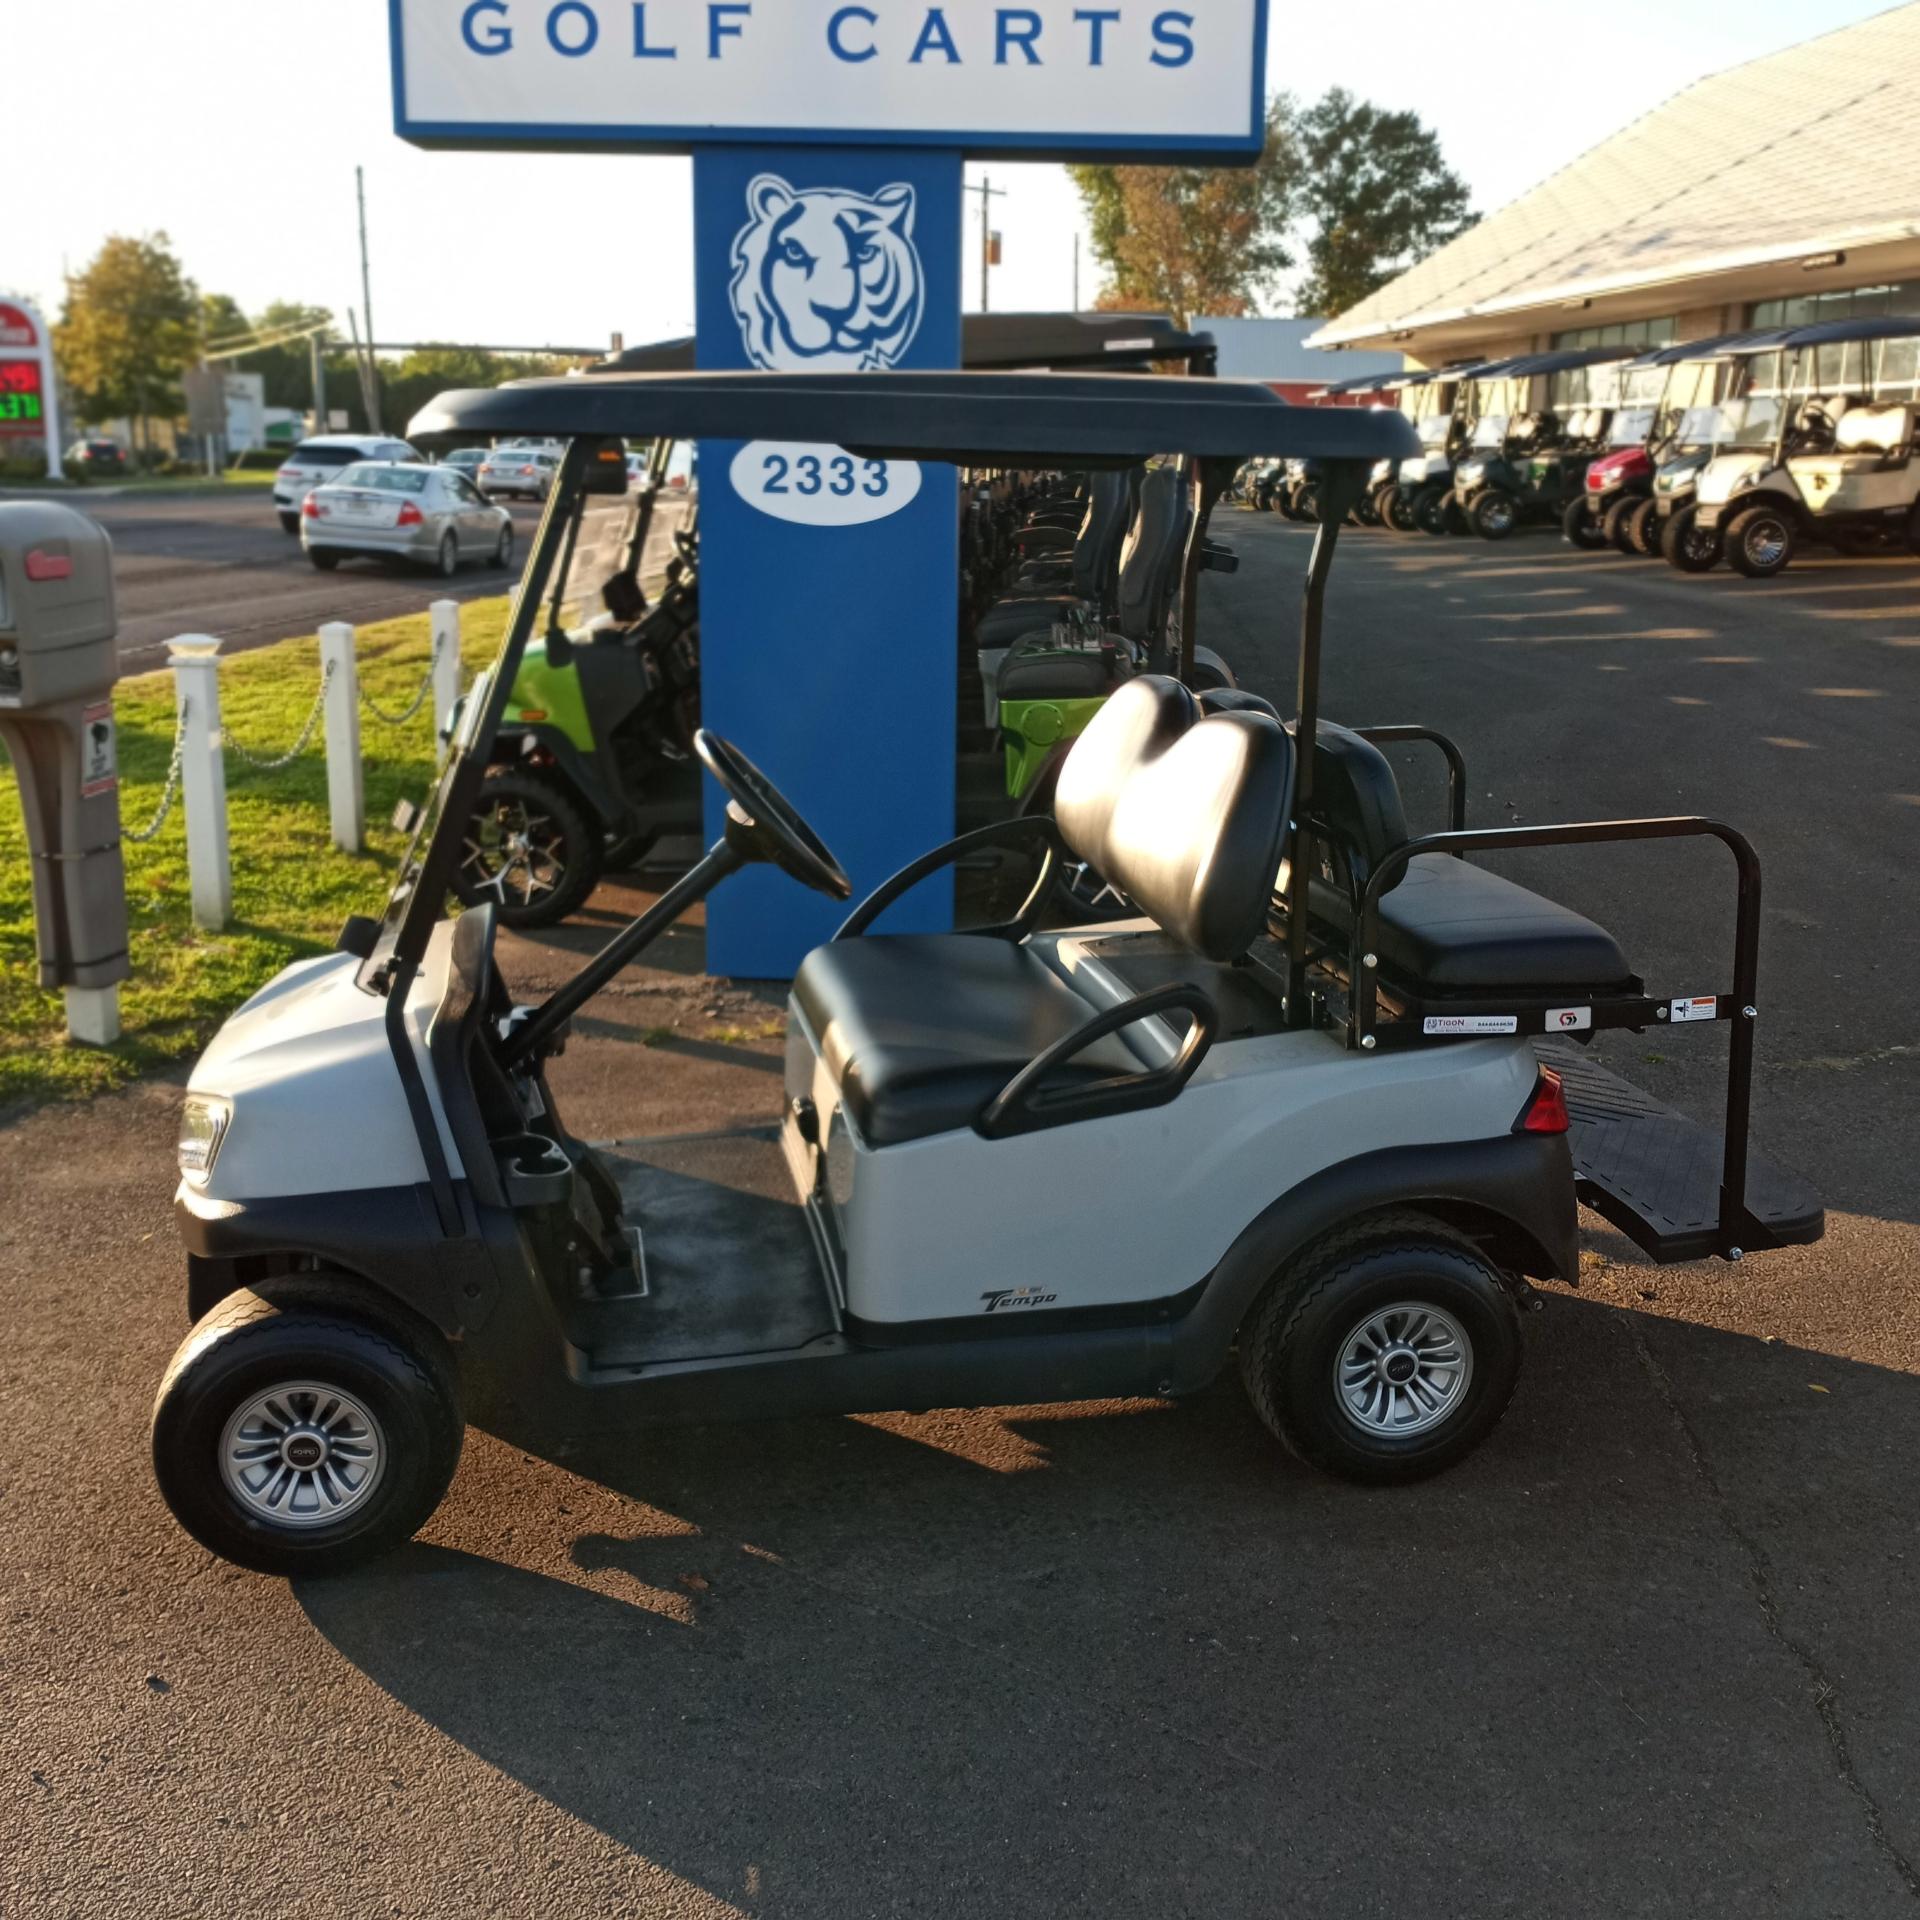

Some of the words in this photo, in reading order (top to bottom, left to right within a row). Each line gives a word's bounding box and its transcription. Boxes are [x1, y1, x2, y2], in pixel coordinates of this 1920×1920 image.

[461, 0, 751, 59] GOLF
[827, 6, 1194, 68] CARTS
[763, 454, 889, 497] 2333
[980, 1288, 1057, 1311] Tempo
